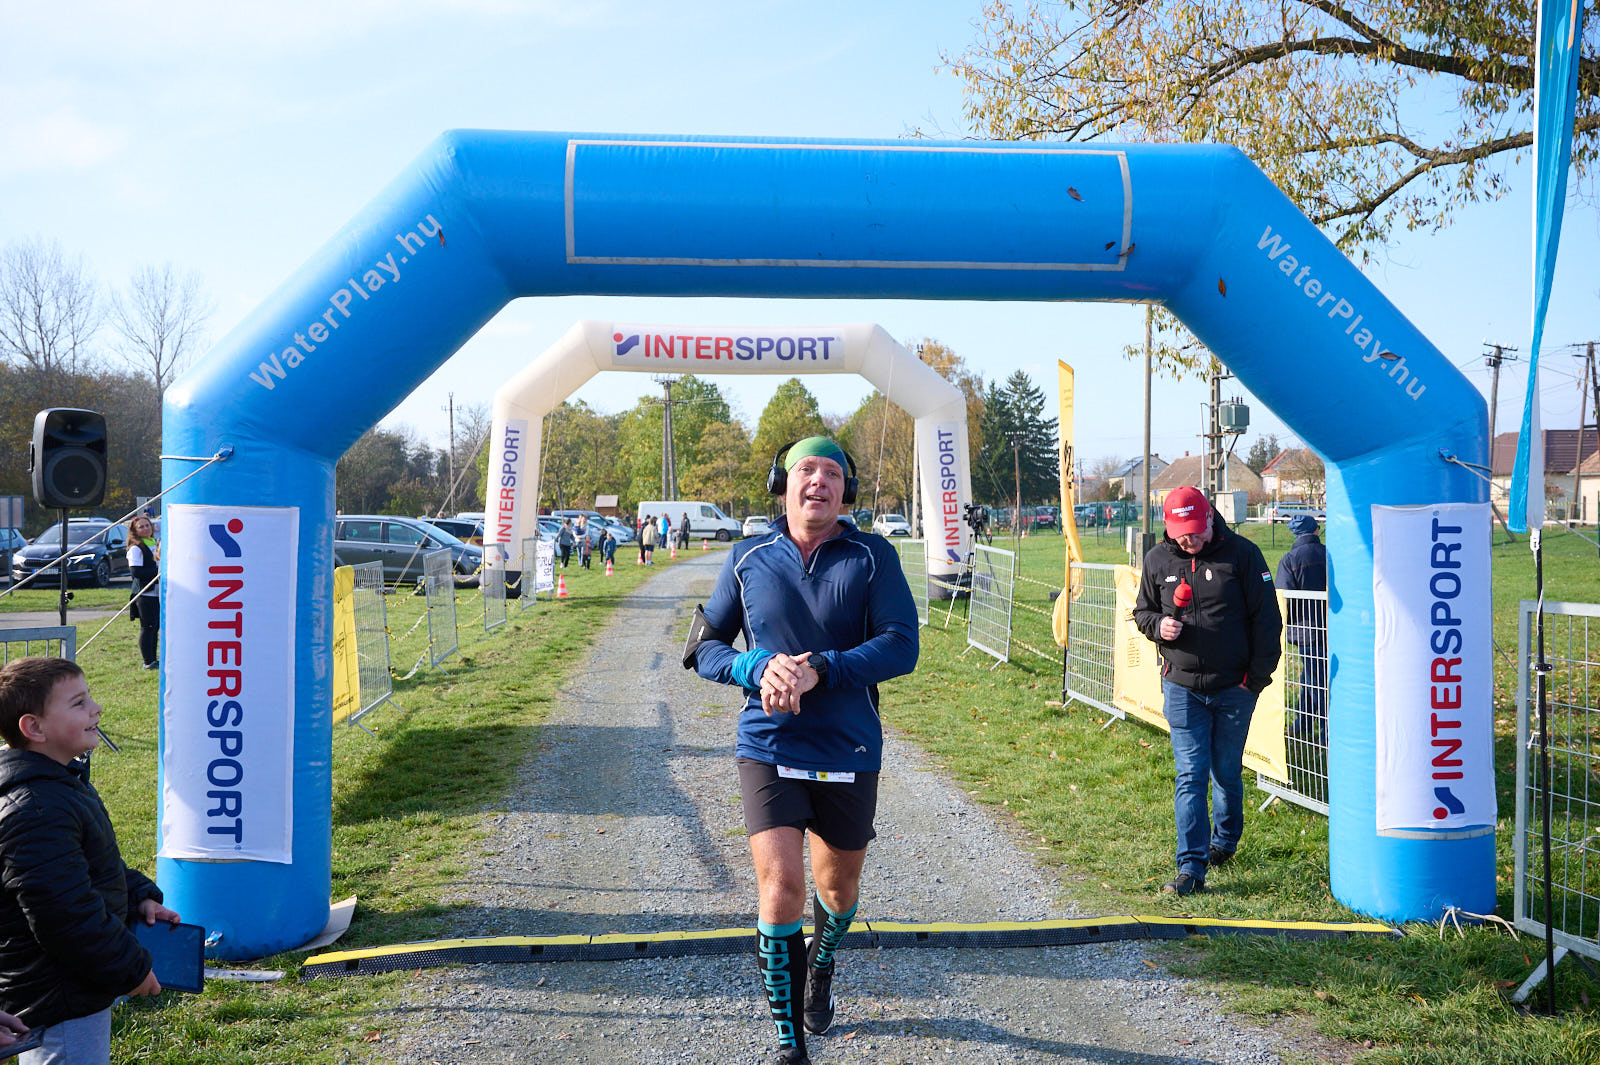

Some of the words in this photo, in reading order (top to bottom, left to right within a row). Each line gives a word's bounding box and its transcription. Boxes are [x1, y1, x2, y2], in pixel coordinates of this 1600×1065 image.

[248, 214, 442, 391] WaterPlay.hu
[644, 334, 835, 361] INTERSPORT
[1257, 225, 1427, 401] WaterPlay.hu
[496, 425, 520, 543] INTERSPORT
[938, 429, 960, 546] INTERSPORT
[206, 565, 244, 844] INTERSPORT
[1429, 517, 1464, 780] INTERSPORT
